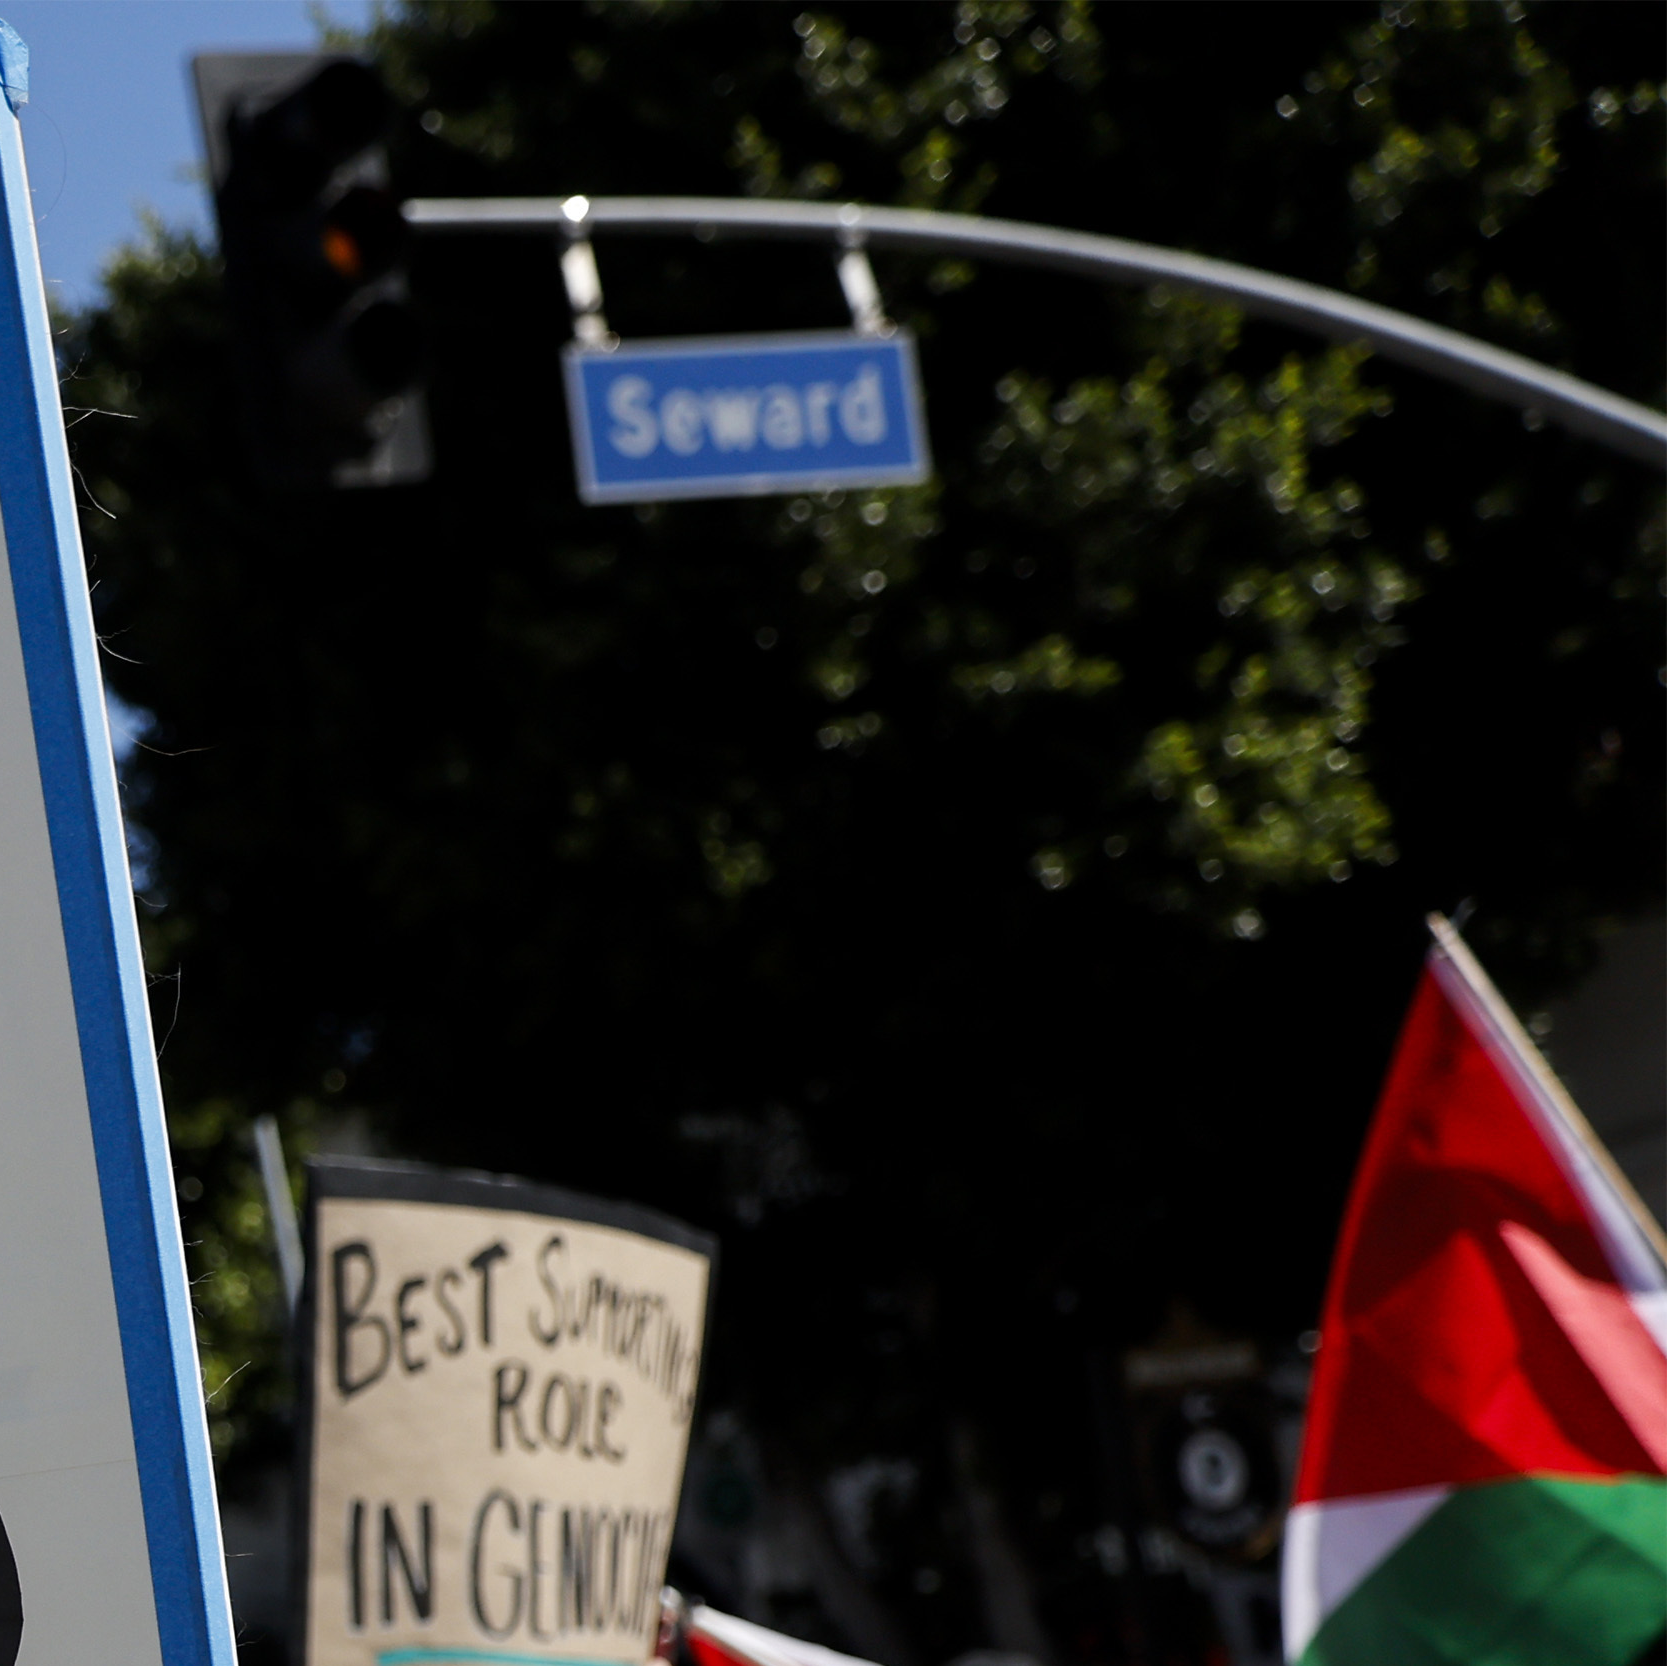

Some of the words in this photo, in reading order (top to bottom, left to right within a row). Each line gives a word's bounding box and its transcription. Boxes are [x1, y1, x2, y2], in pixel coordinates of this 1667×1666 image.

[606, 364, 888, 459] Seward
[493, 1358, 624, 1465] ROLE
[350, 1498, 434, 1630] IN
